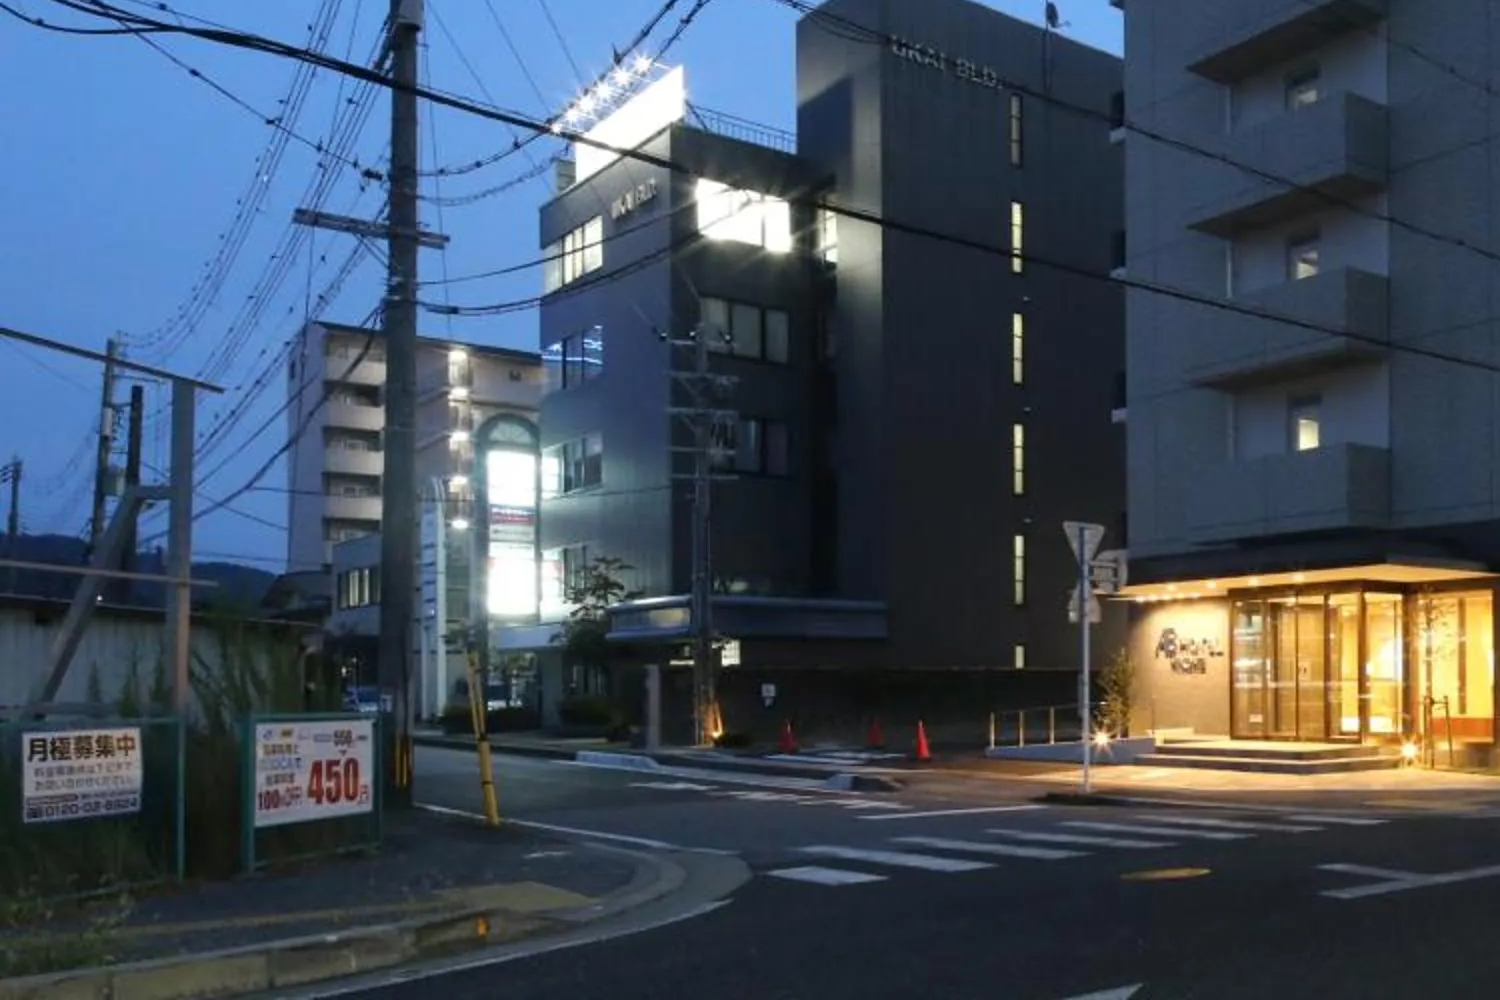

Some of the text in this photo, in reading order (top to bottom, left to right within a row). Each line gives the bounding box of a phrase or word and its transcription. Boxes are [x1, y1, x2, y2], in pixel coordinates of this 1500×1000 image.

[28, 733, 136, 762] 月極募集中
